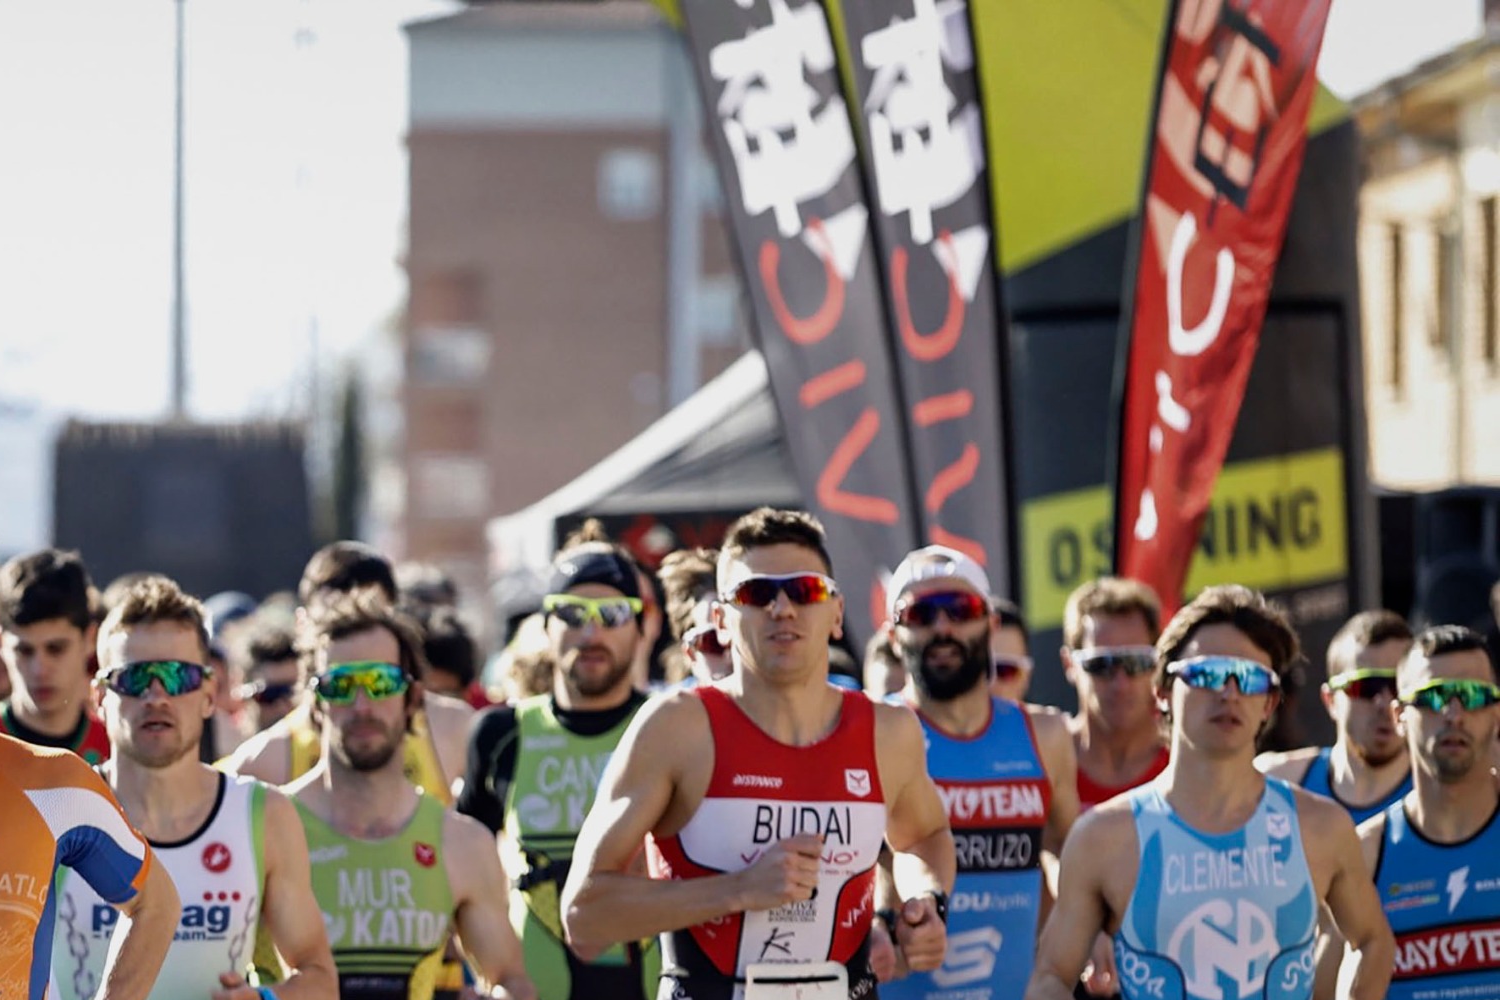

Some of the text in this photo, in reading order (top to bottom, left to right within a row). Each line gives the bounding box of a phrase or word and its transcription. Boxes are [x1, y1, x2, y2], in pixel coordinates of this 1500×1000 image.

[752, 804, 851, 845] BUDAI
[337, 867, 416, 910] MUR
[1164, 844, 1288, 896] CLEMENTE
